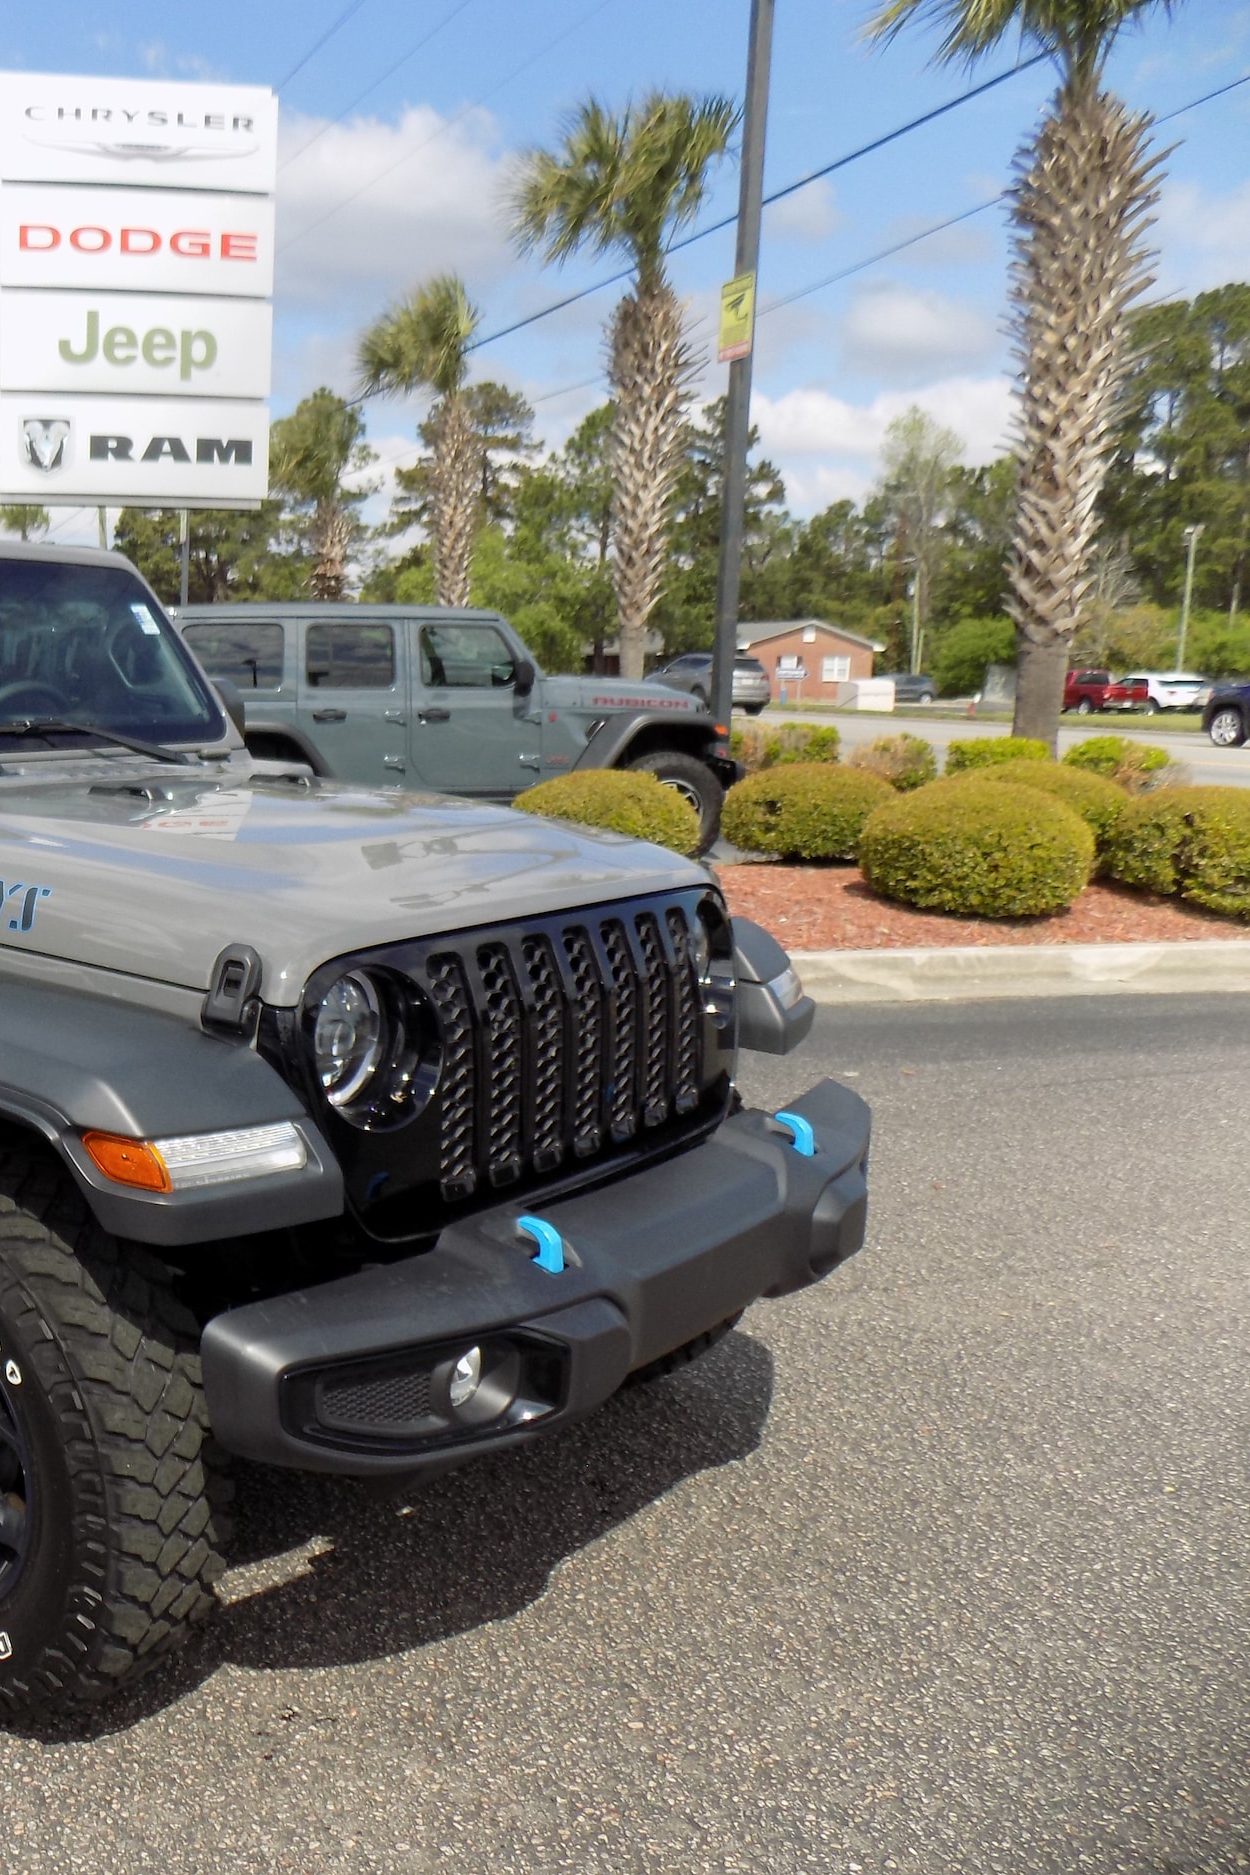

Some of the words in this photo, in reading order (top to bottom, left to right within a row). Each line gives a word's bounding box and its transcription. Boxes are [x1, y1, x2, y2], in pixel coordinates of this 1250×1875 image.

[25, 105, 254, 133] CHRYSLER
[19, 225, 258, 262] DODGE
[58, 310, 218, 381] Jeep
[89, 435, 253, 465] RAM
[592, 696, 689, 709] RUBICON
